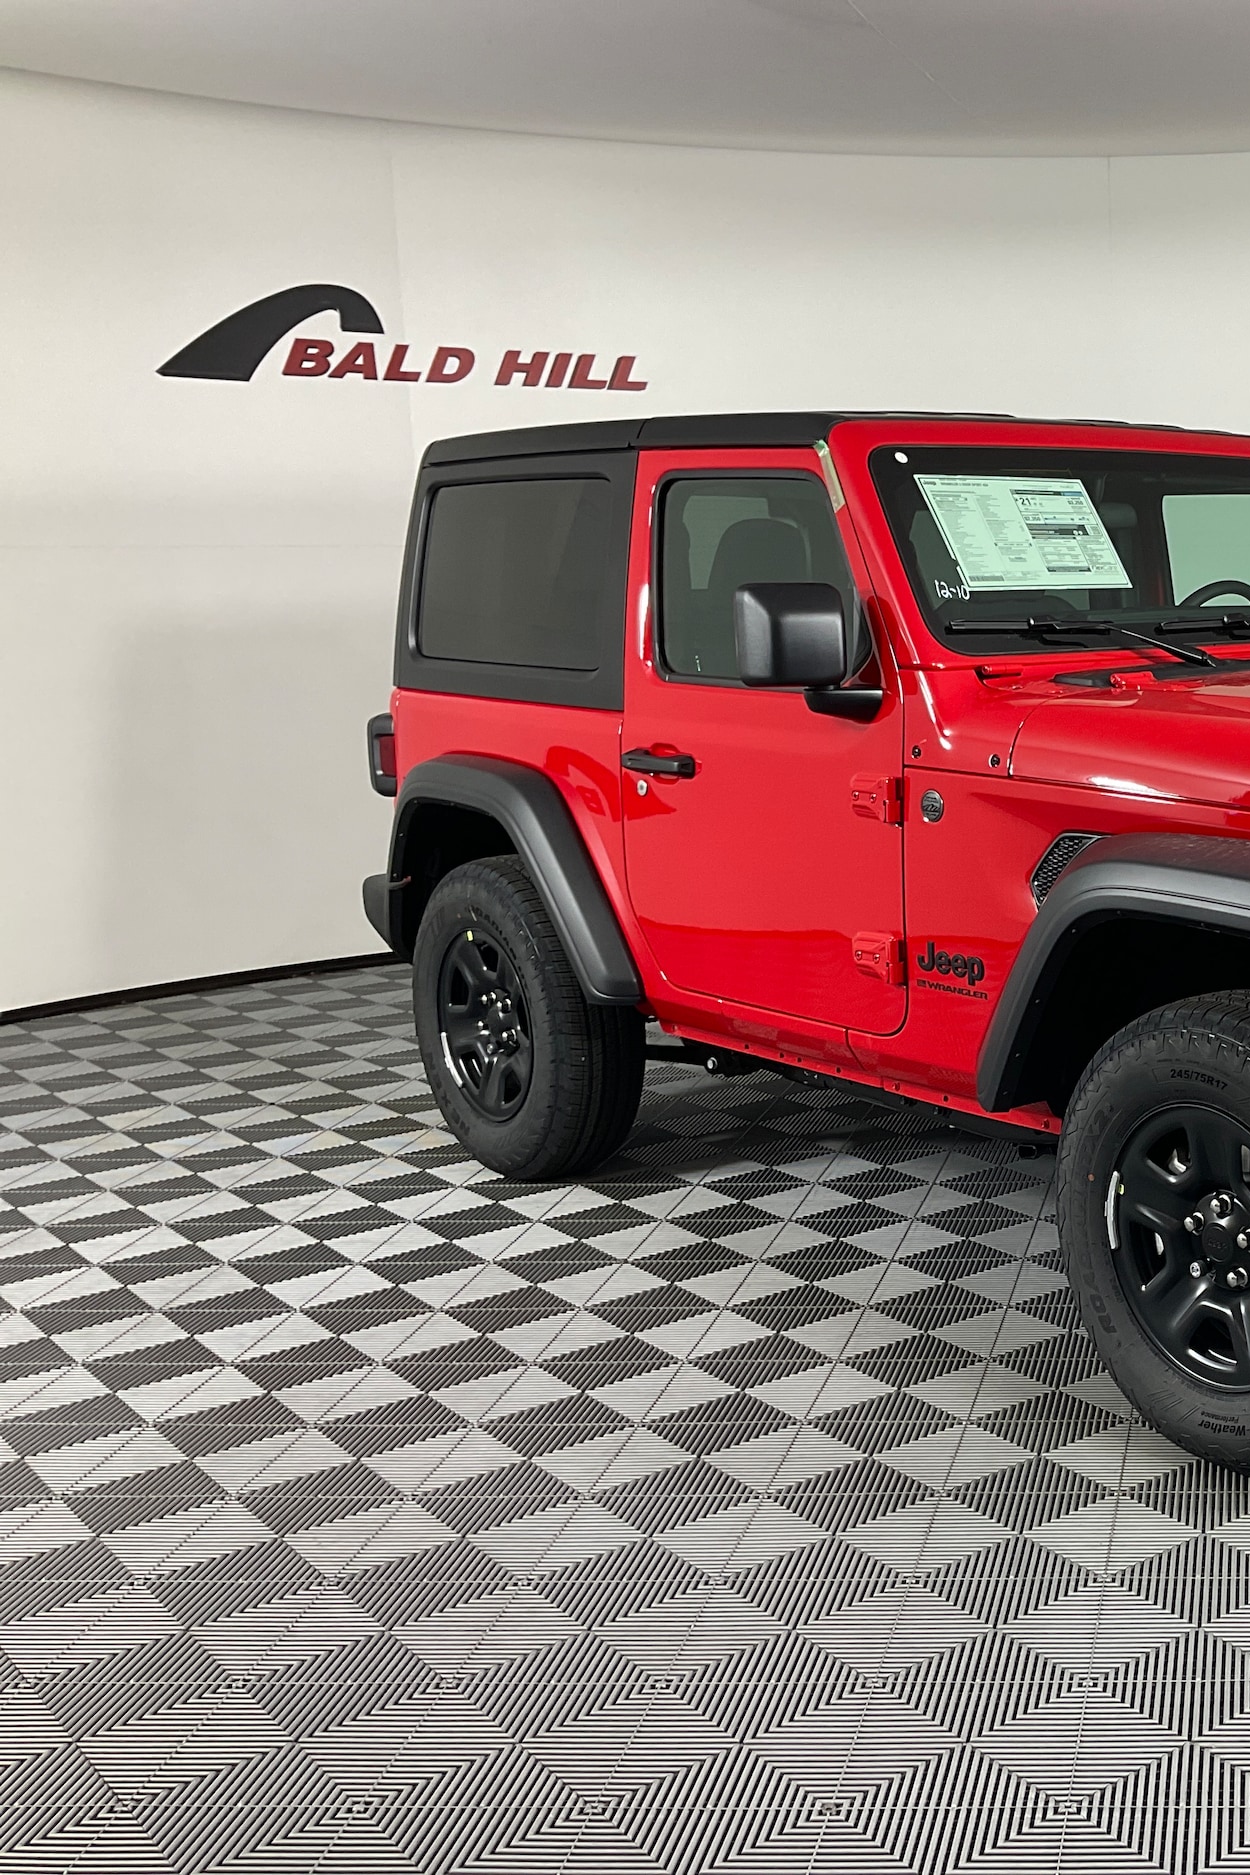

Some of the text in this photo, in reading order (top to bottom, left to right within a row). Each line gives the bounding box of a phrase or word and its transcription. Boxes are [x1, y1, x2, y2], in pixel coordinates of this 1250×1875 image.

[282, 337, 648, 391] BALD HILL
[934, 579, 970, 600] 12-10
[917, 941, 985, 986] Jeep
[927, 980, 988, 1000] WRANGLER
[1169, 1068, 1229, 1091] 245/75R17
